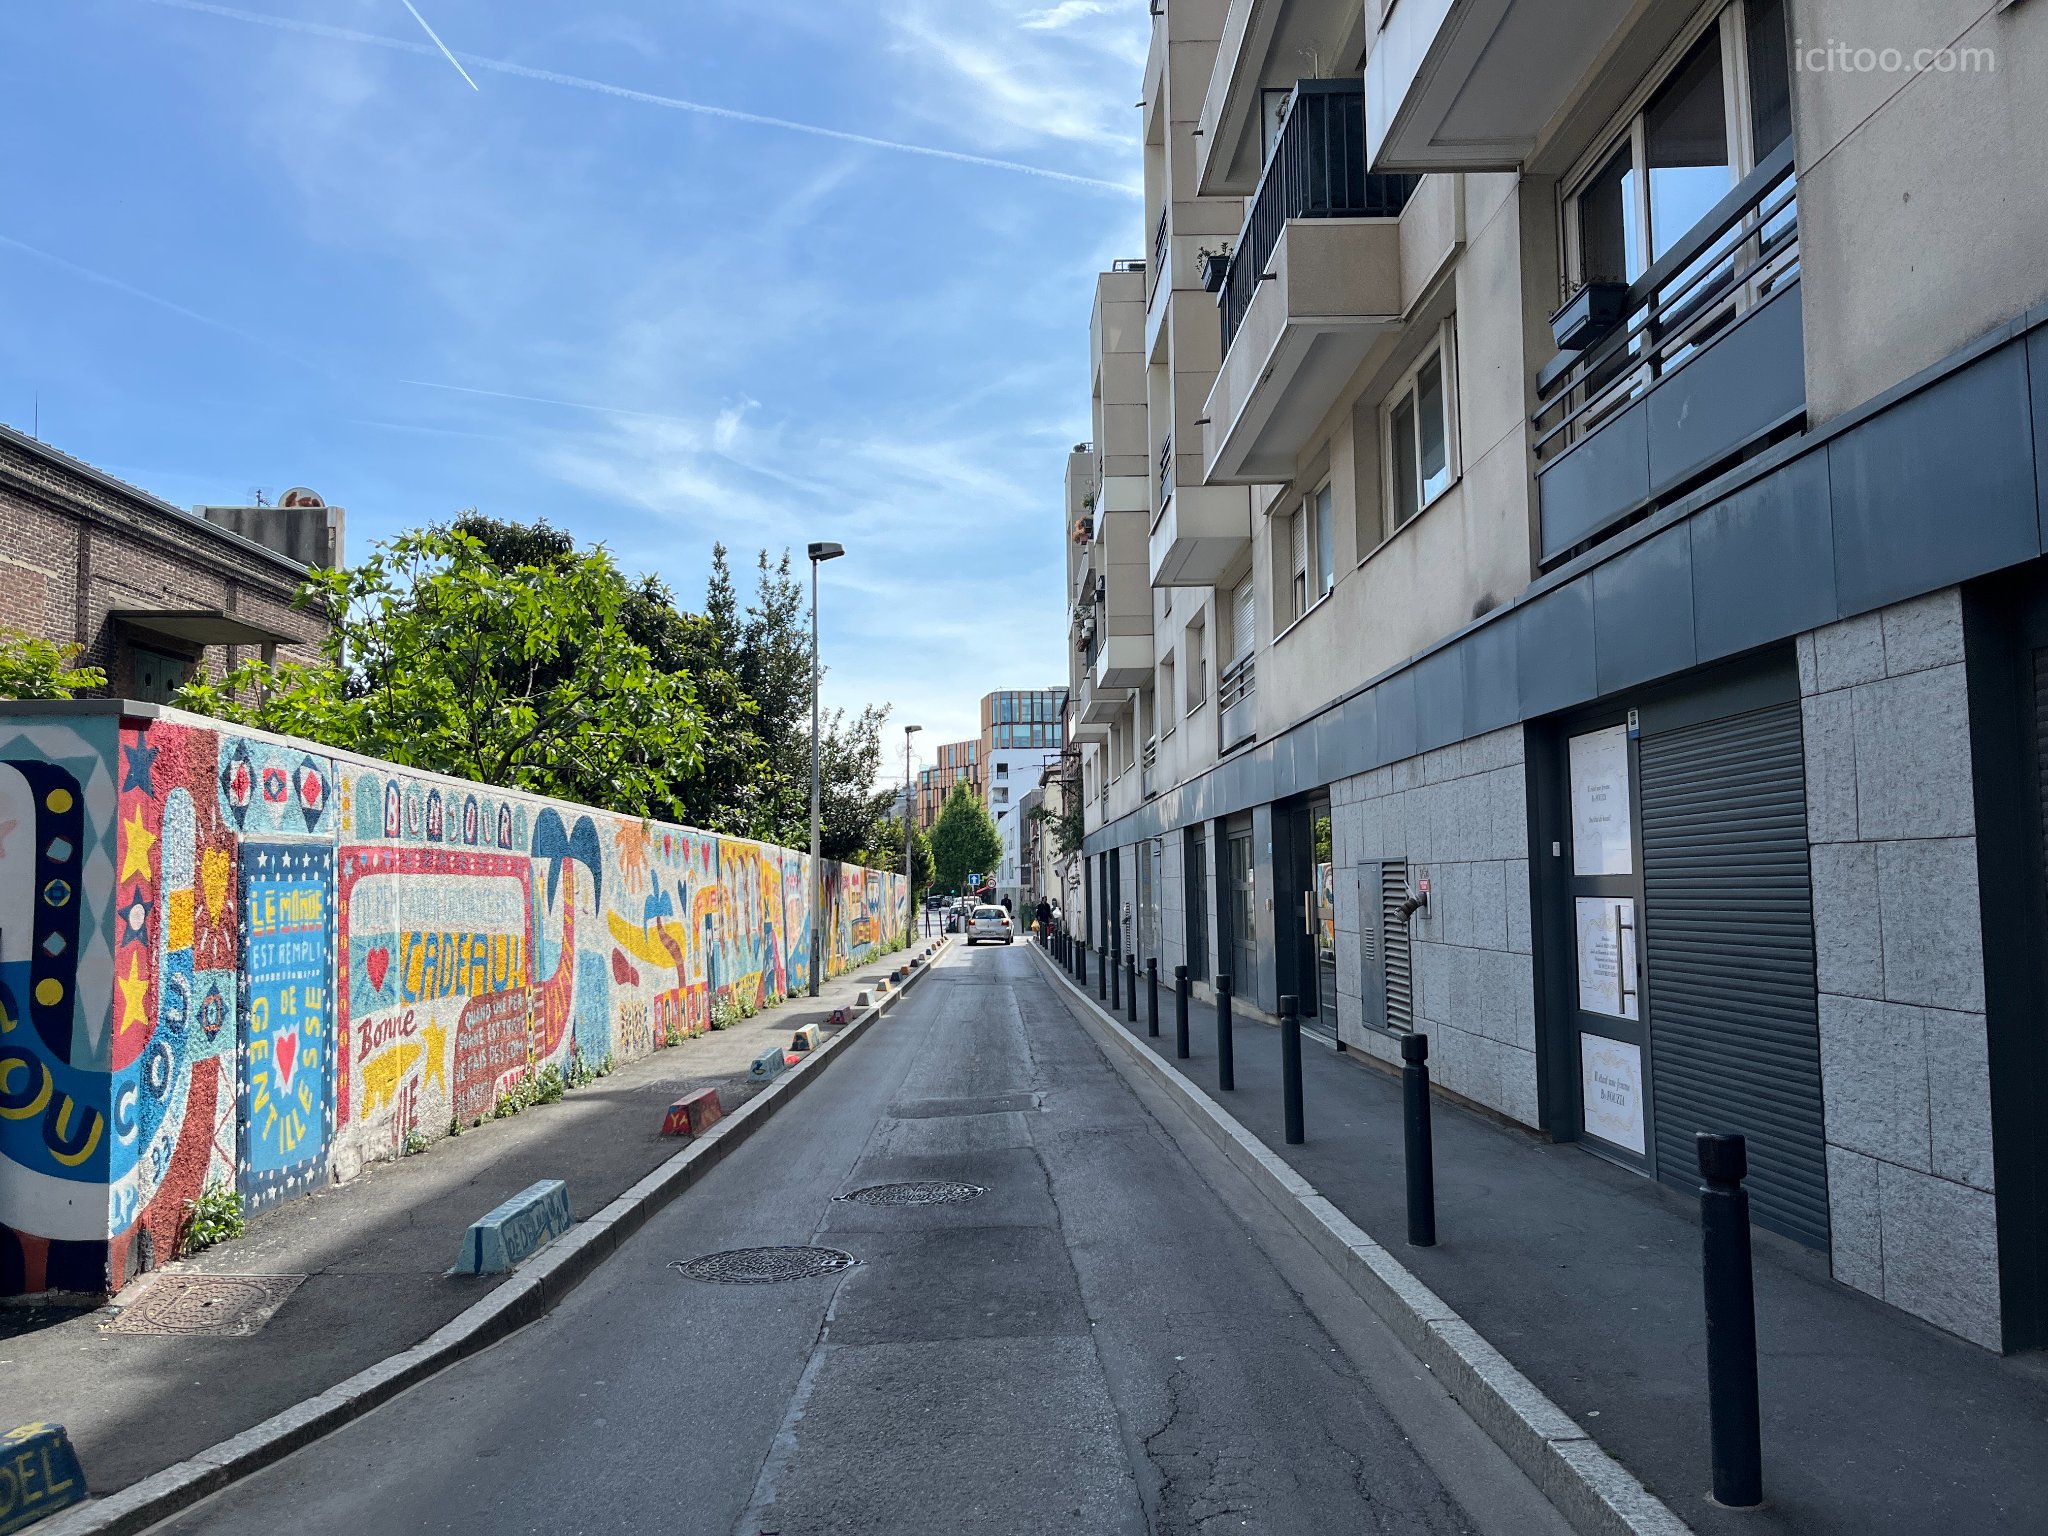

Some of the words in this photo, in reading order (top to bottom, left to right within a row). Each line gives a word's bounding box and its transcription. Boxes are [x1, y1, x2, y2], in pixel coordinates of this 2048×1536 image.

[253, 943, 276, 970] EST
[278, 940, 321, 966] REMPLI
[401, 931, 522, 1004] CADEAUX
[280, 985, 297, 1016] DE
[357, 1010, 418, 1064] Bonne
